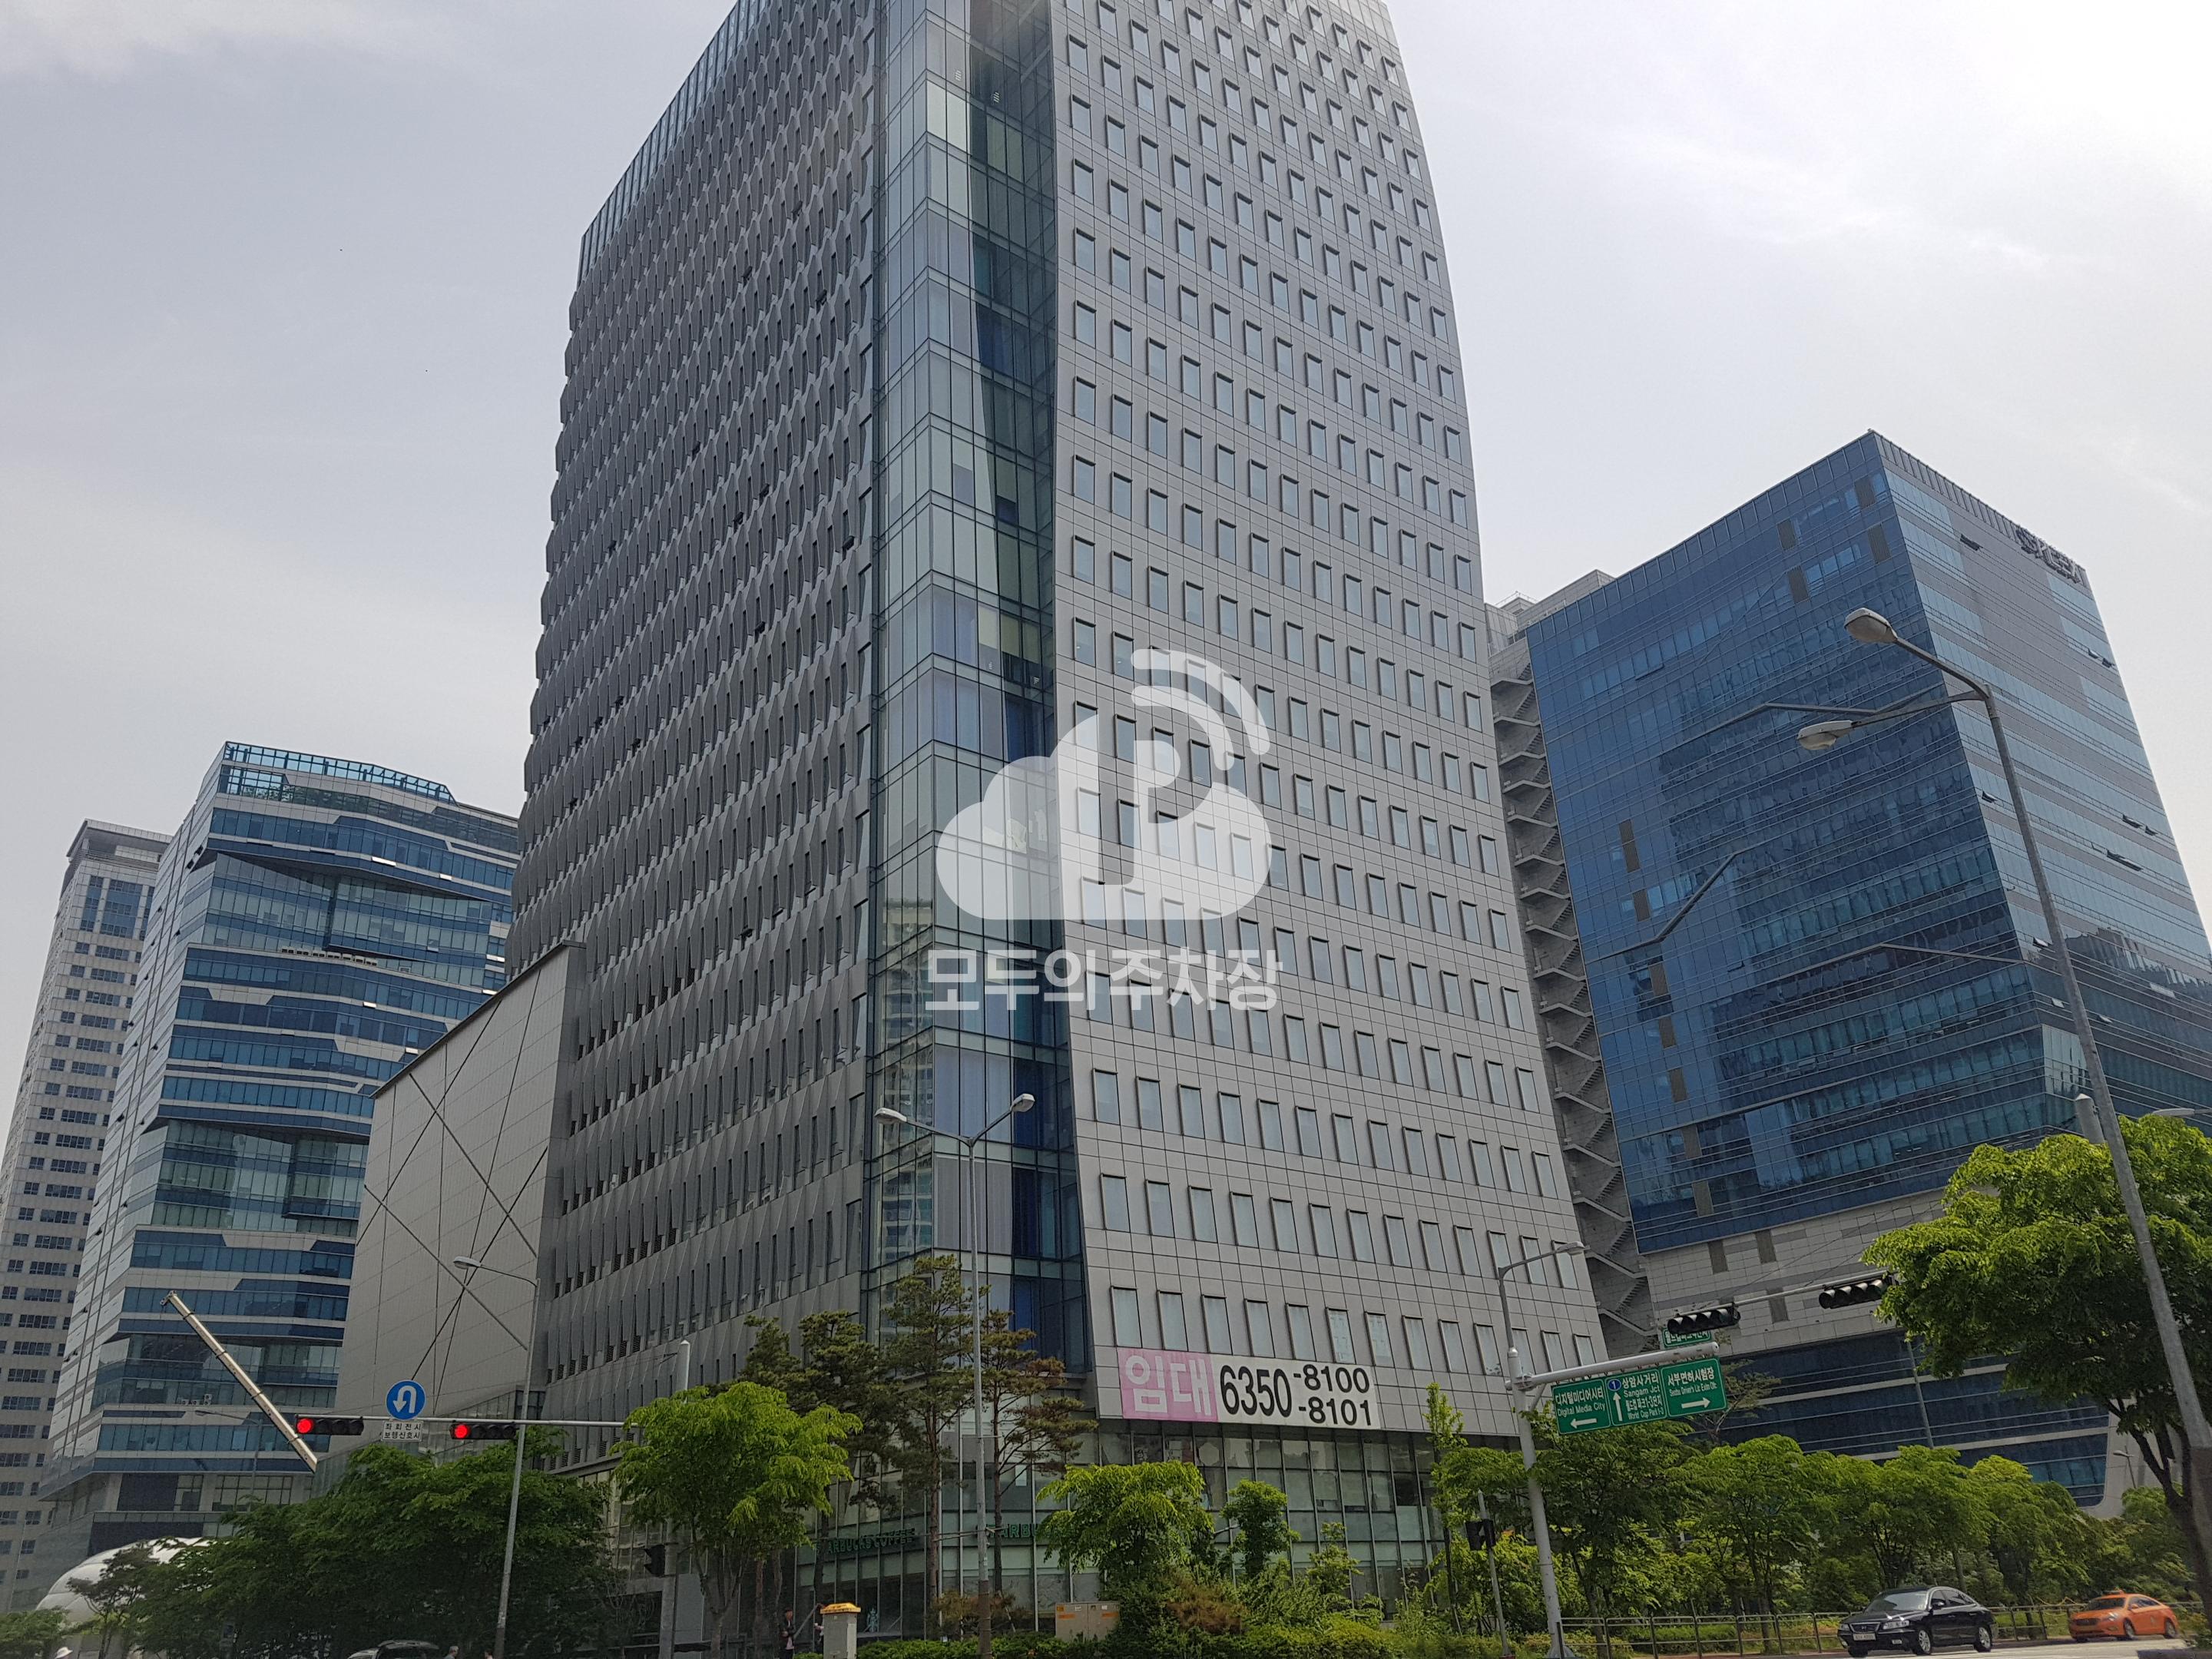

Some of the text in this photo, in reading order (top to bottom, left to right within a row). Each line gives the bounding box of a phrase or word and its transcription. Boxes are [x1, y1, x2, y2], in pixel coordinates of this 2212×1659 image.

[1125, 1355, 1212, 1416] 임대
[1622, 1372, 1658, 1389] 상암사거리
[1667, 1366, 1715, 1386] 서부면허시험장
[1555, 1386, 1604, 1406] 디지털미디어시티
[1624, 1385, 1660, 1398] Sangam Jct
[1558, 1402, 1605, 1418] Digital Media City
[816, 1535, 872, 1555] SARBUCKS
